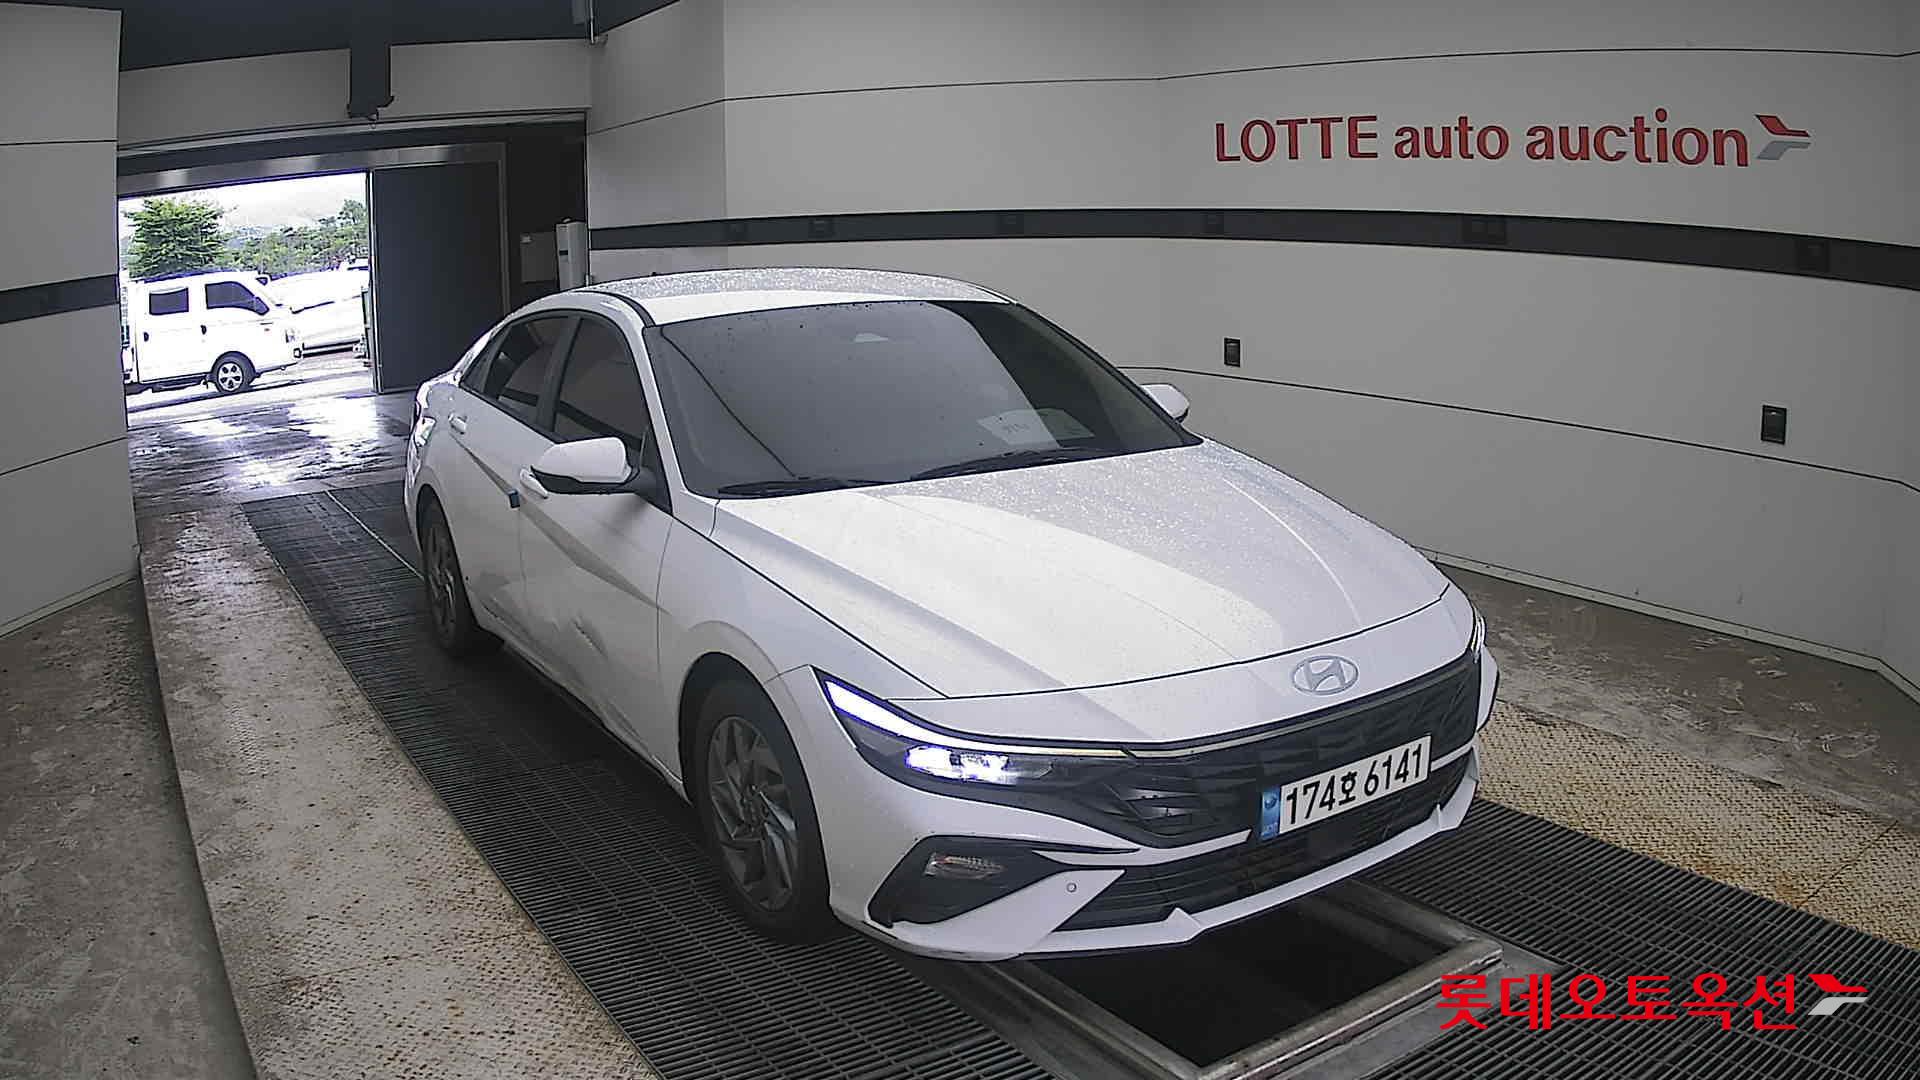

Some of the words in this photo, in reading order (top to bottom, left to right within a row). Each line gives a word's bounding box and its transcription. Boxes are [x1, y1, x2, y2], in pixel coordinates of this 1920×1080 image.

[1215, 116, 1377, 162] LOTTE
[1394, 115, 1509, 160] auto
[1525, 108, 1749, 167] auction
[1286, 771, 1358, 825] 174호
[1364, 743, 1423, 797] 6141
